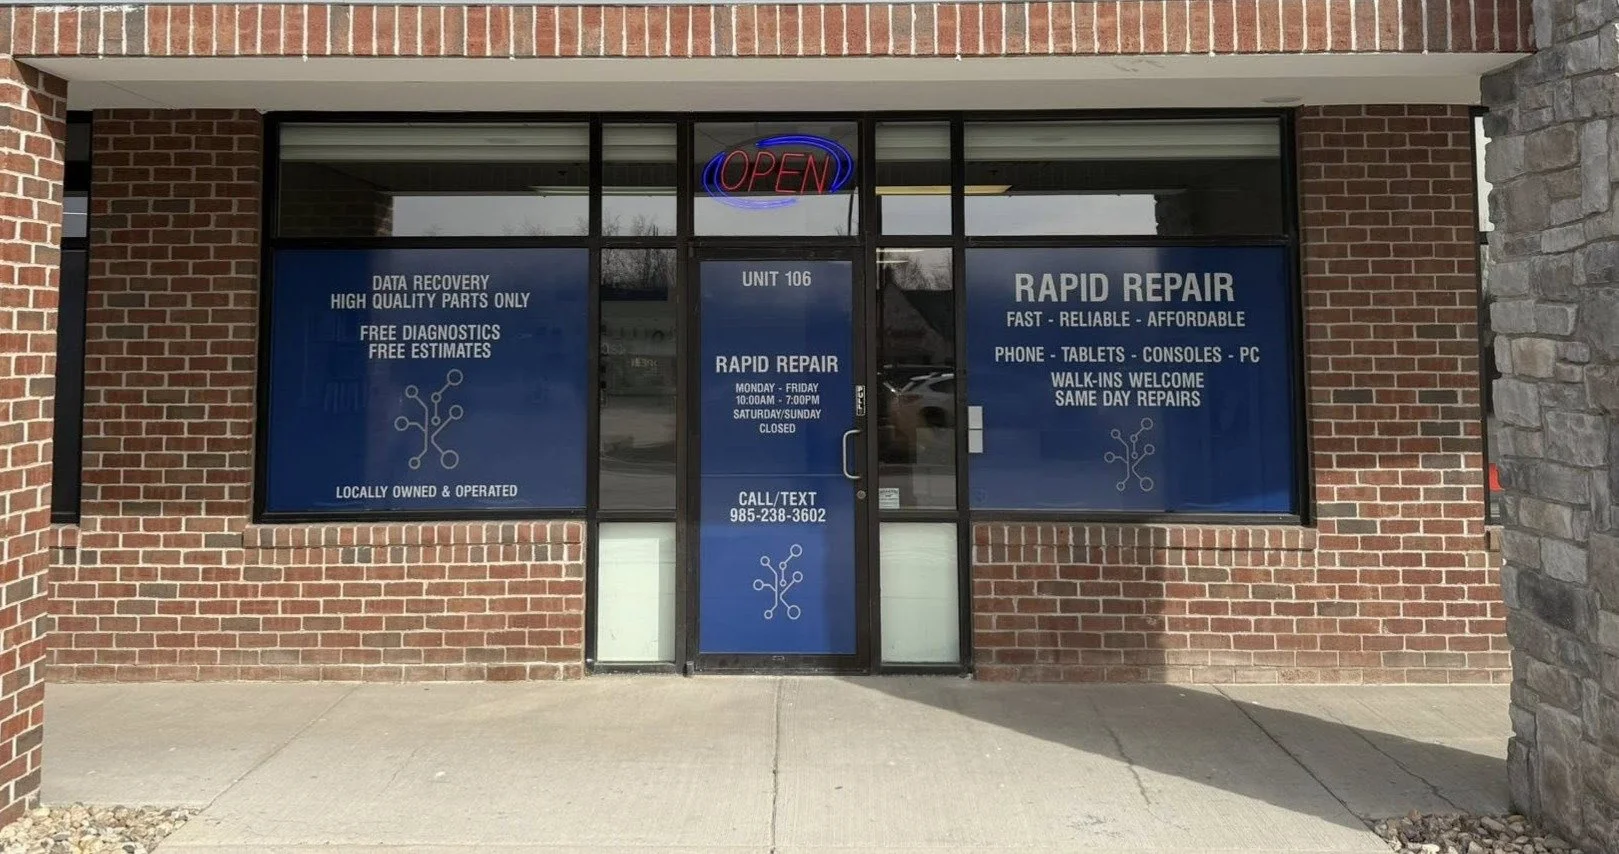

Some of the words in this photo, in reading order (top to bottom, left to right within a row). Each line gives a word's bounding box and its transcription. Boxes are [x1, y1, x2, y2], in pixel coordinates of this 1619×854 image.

[720, 150, 830, 194] OPEN
[373, 275, 407, 290] DATA
[413, 275, 489, 290] RECOVERY
[743, 271, 779, 286] UNIT
[785, 271, 811, 286] 106
[1016, 273, 1108, 302] RAPID
[1124, 273, 1234, 302] REPAIR
[331, 293, 366, 308] HIGH
[372, 292, 436, 308] QUALITY
[442, 292, 488, 308] PARTS
[494, 292, 530, 308] ONLY
[1007, 311, 1043, 327] FAST
[1060, 311, 1130, 327] RELIABLE
[1147, 311, 1245, 327] AFFORDABLE
[360, 325, 396, 341] FREE
[403, 324, 500, 340] DIAGNOSTICS
[369, 343, 405, 359] FREE
[411, 343, 491, 358] ESTIMATES
[995, 346, 1044, 362] PHONE
[1061, 346, 1125, 363] TABLETS
[1143, 346, 1222, 363] CONSOLES
[1240, 347, 1260, 363] PC
[716, 356, 769, 373] RAPID
[777, 355, 838, 372] REPAIR
[736, 383, 775, 393] MONDAY
[786, 383, 818, 393] FRIDAY
[1051, 372, 1123, 388] WALK-INS
[1128, 372, 1204, 388] WELCOME
[736, 395, 775, 405] 10:00AM
[786, 395, 819, 405] 7:00PM
[1055, 390, 1097, 406] SAME
[1101, 390, 1131, 406] DAY
[1137, 390, 1200, 407] REPAIRS
[733, 409, 821, 420] SATURDAY/SUNDAY
[759, 423, 796, 433] CLOSED
[336, 484, 388, 498] LOCALLY
[393, 485, 437, 498] OWNED
[442, 485, 450, 497] &
[454, 484, 518, 497] OPERATED
[739, 491, 817, 506] CALL/TEXT
[730, 508, 826, 523] 985-238-3602
